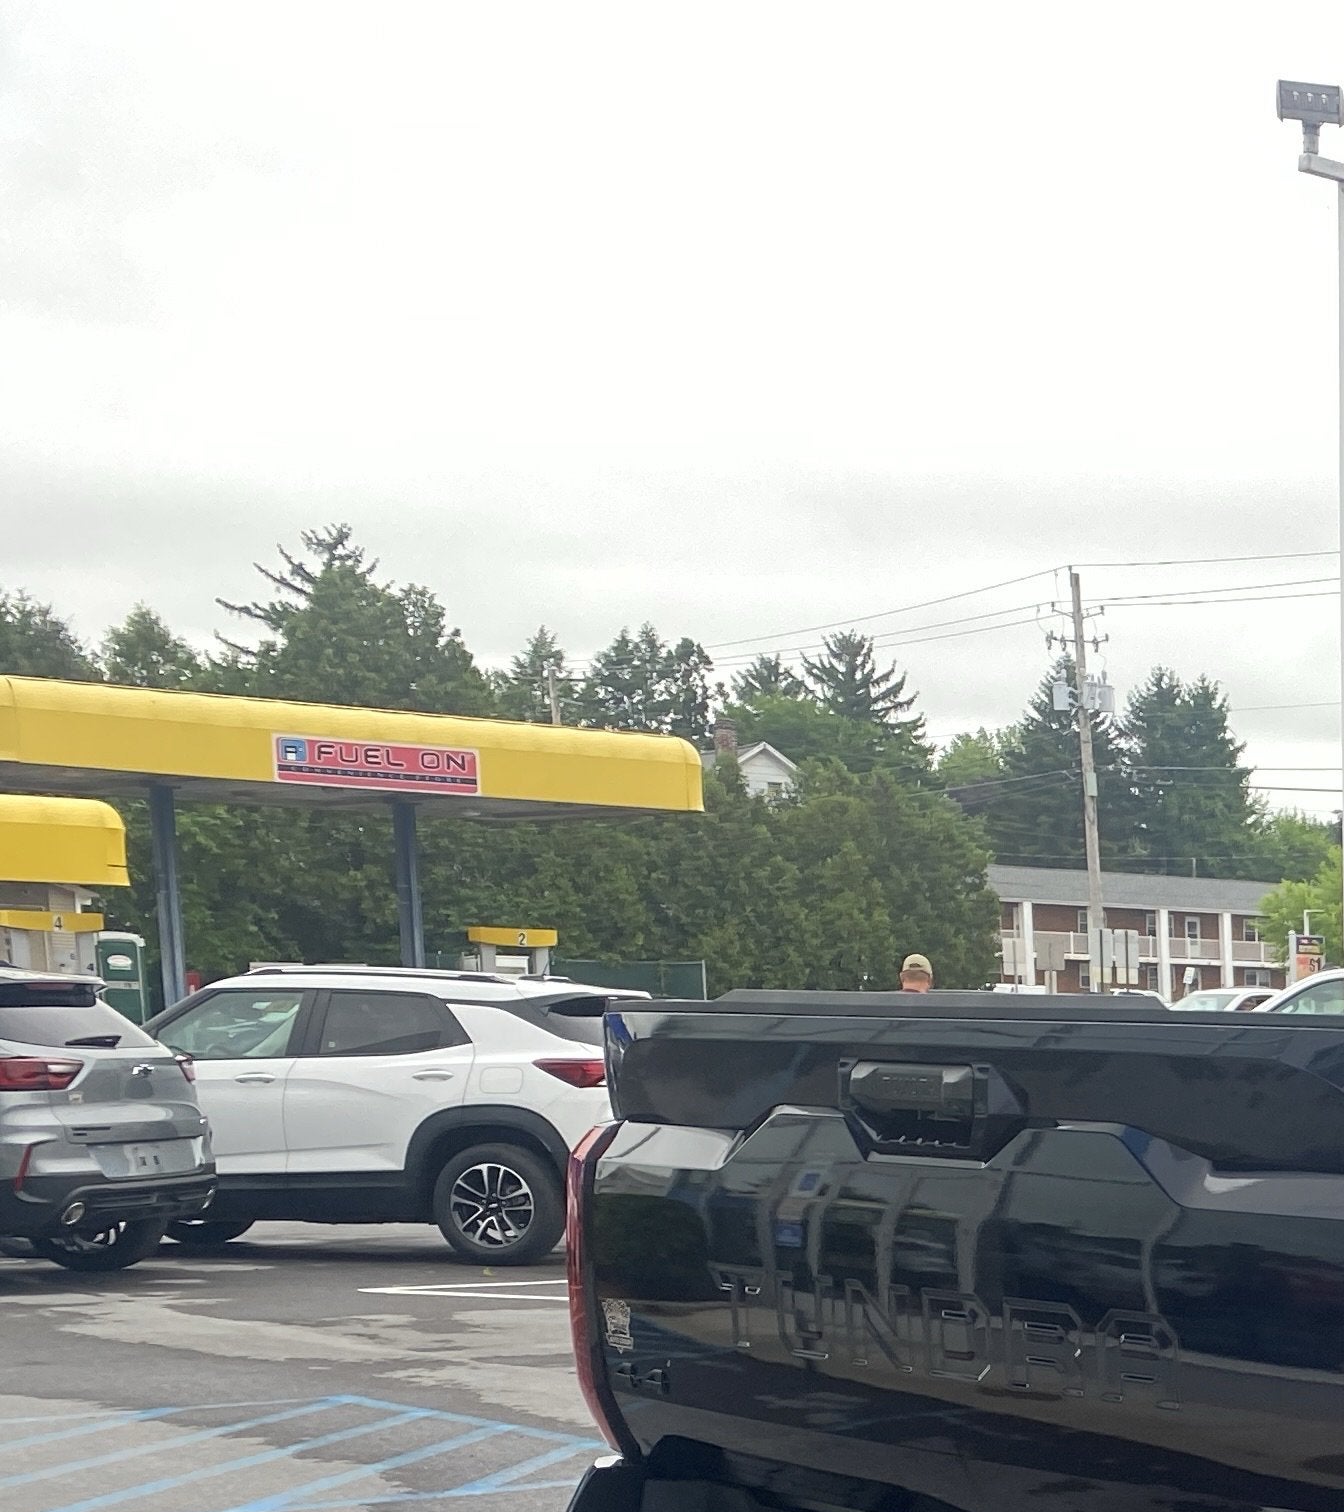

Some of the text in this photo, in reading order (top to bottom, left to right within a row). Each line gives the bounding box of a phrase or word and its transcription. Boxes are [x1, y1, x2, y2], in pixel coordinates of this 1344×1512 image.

[315, 743, 468, 772] FUEL ON
[54, 916, 63, 930] 4
[518, 932, 526, 946] 2
[707, 1259, 1181, 1411] TUNDRA
